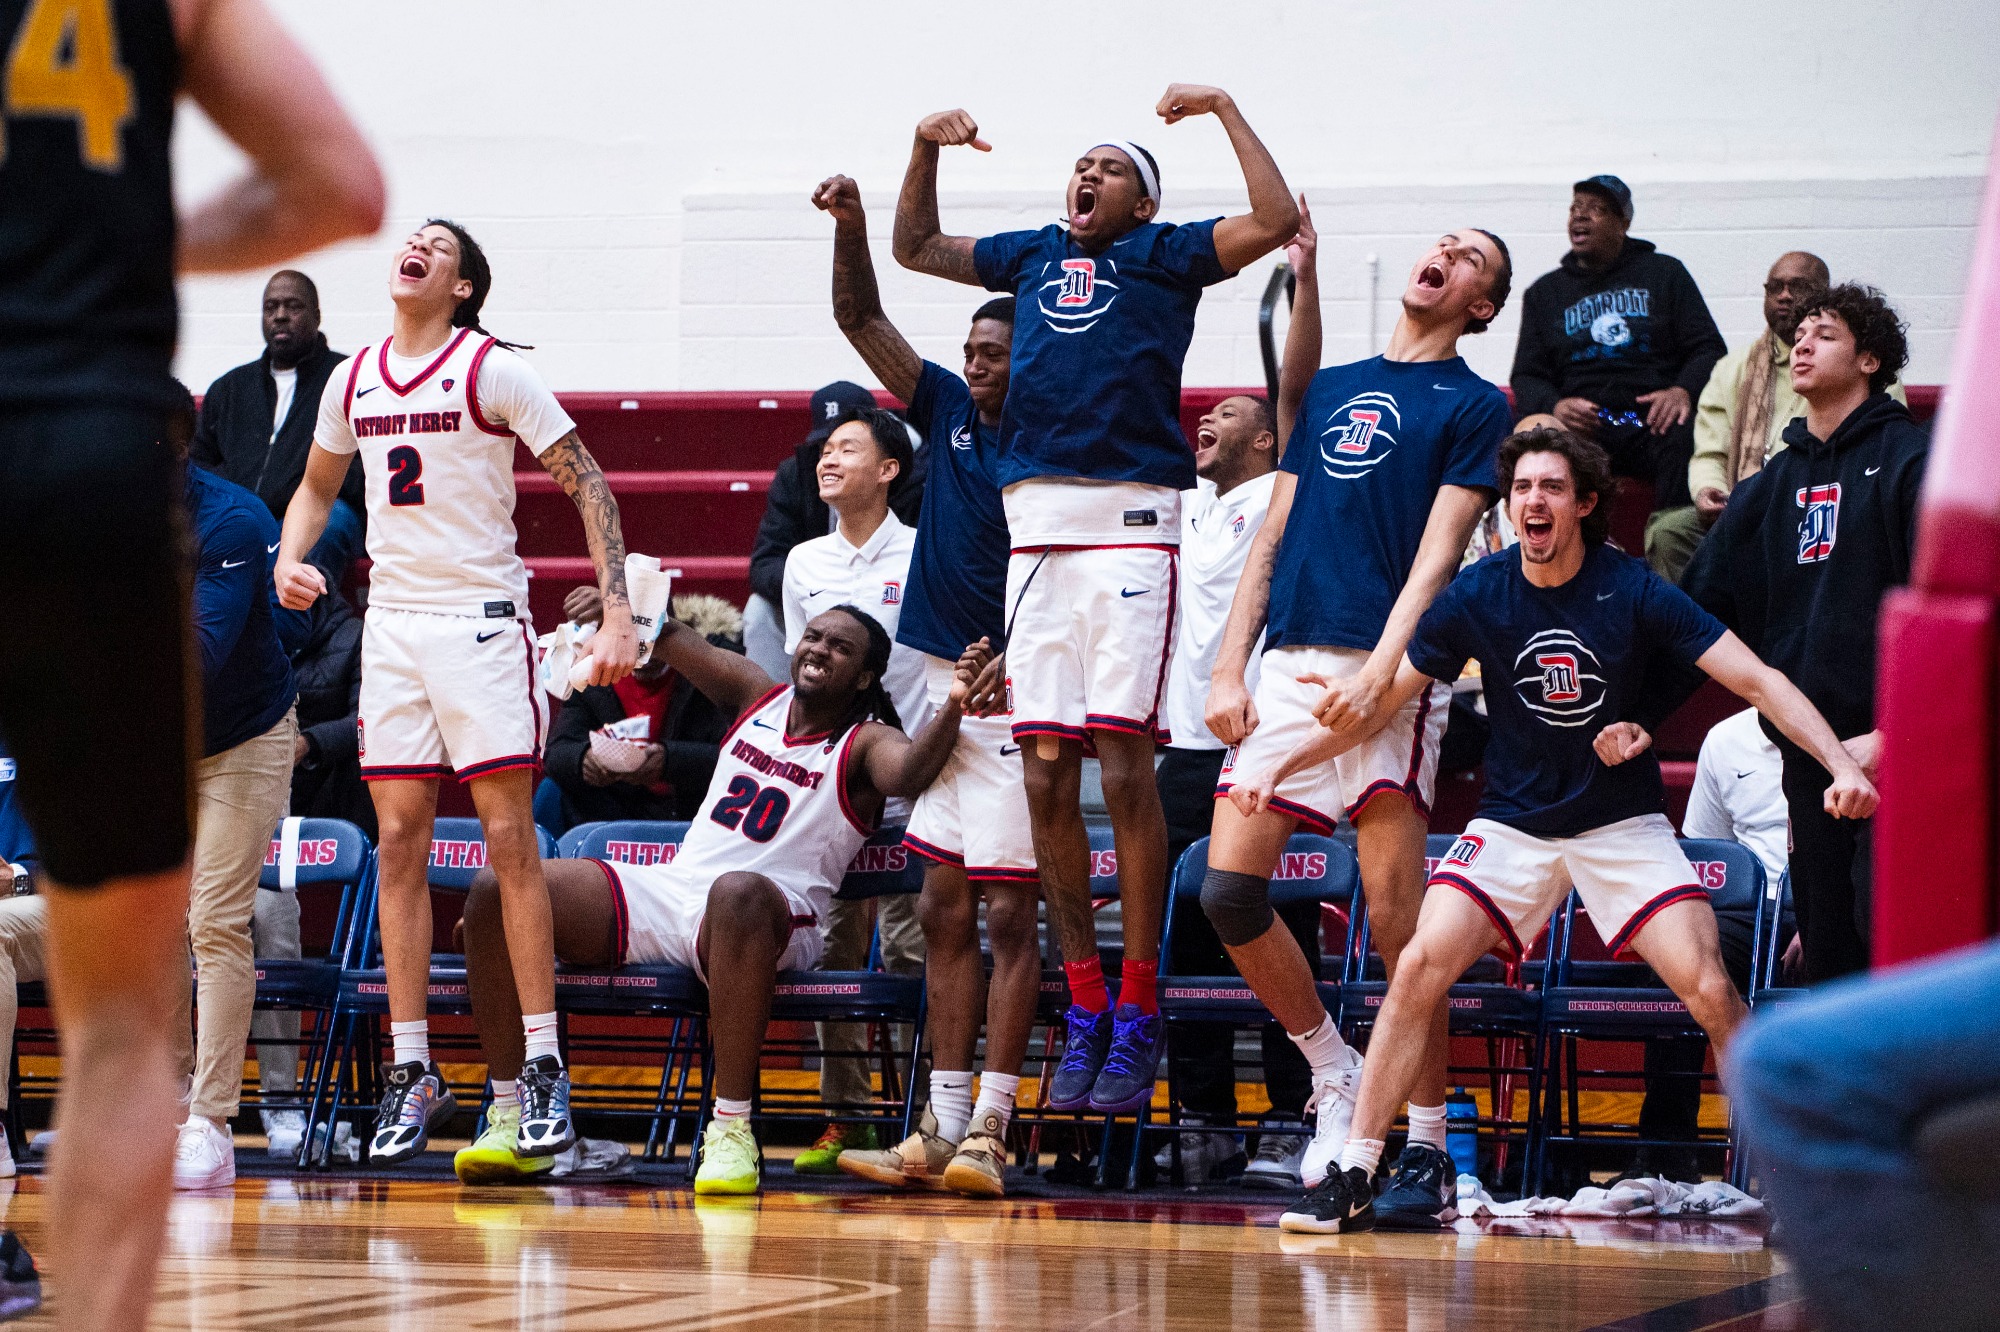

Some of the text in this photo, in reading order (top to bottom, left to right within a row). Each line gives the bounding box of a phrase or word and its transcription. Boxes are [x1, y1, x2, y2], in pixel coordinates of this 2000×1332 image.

[1564, 287, 1650, 336] DETROIT
[824, 401, 840, 420] D
[353, 410, 462, 438] DETROIT MERCY
[387, 444, 425, 507] 2
[730, 738, 824, 791] DETROIT MERCY
[709, 773, 791, 844] 20
[606, 840, 683, 867] TITA
[847, 845, 907, 872] ANS
[1271, 853, 1327, 880] ANS
[358, 983, 388, 993] DETRO
[441, 985, 467, 995] TEAM
[591, 976, 629, 986] COLEGE
[630, 977, 657, 987] TEAM
[793, 984, 833, 995] COLLEGE
[833, 984, 860, 994] TEAM
[1165, 988, 1209, 998] DETROITS
[1210, 989, 1251, 999] COLLEGE
[1455, 998, 1482, 1008] TEAM
[1569, 1001, 1615, 1011] DETROITS
[1616, 1002, 1658, 1012] COLLEGE
